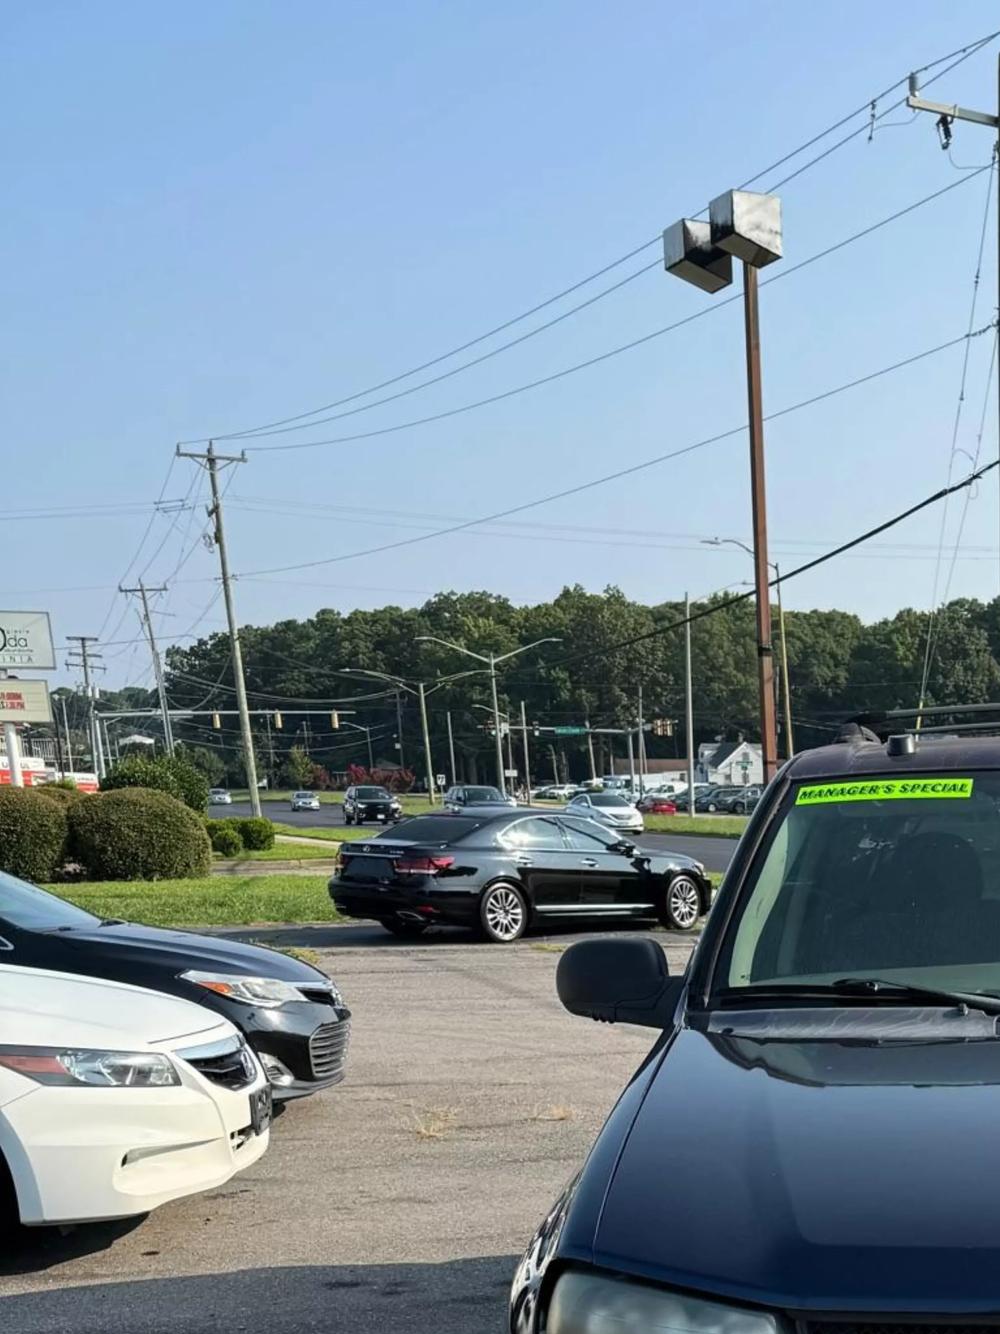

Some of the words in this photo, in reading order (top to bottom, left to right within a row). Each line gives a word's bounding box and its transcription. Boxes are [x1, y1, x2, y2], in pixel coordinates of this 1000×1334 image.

[3, 655, 34, 664] INIA
[799, 783, 894, 800] MANAGER'S
[898, 782, 969, 794] SPECIAL
